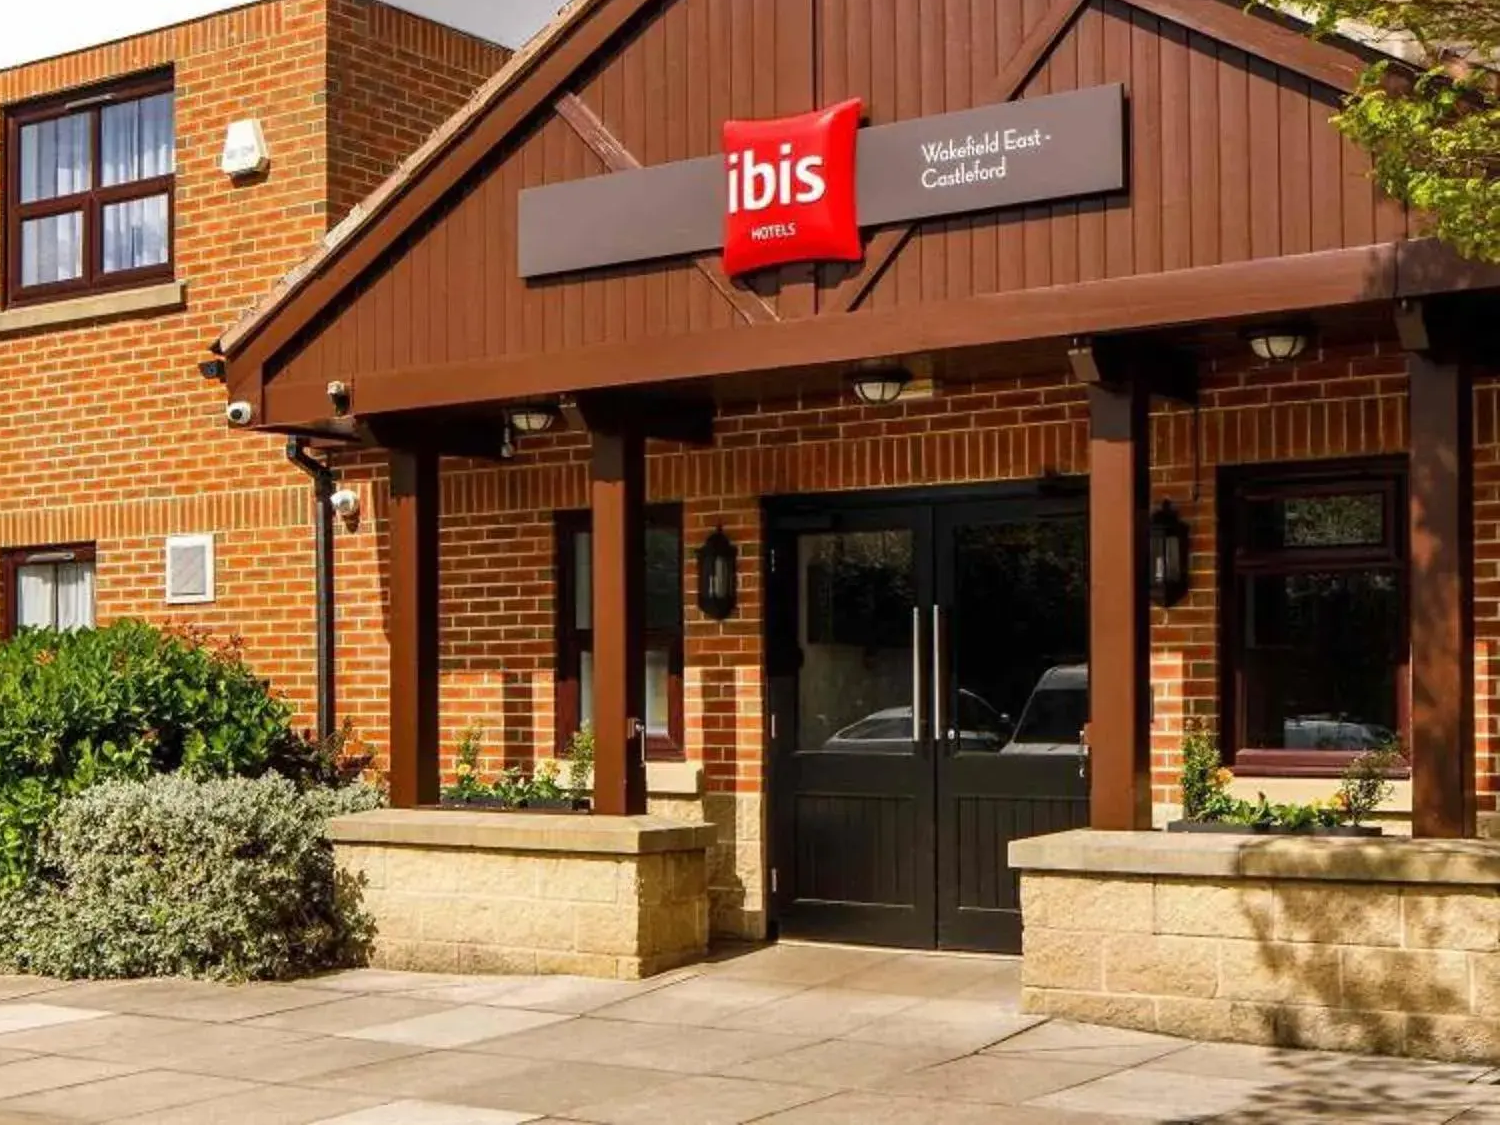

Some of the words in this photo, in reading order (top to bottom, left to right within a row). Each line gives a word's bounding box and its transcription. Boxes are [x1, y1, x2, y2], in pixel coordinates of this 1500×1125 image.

[921, 131, 999, 163] Wakefield
[1004, 129, 1041, 150] East
[728, 142, 826, 213] ibis
[921, 156, 1007, 188] Castleford
[751, 222, 796, 240] HOTELS
